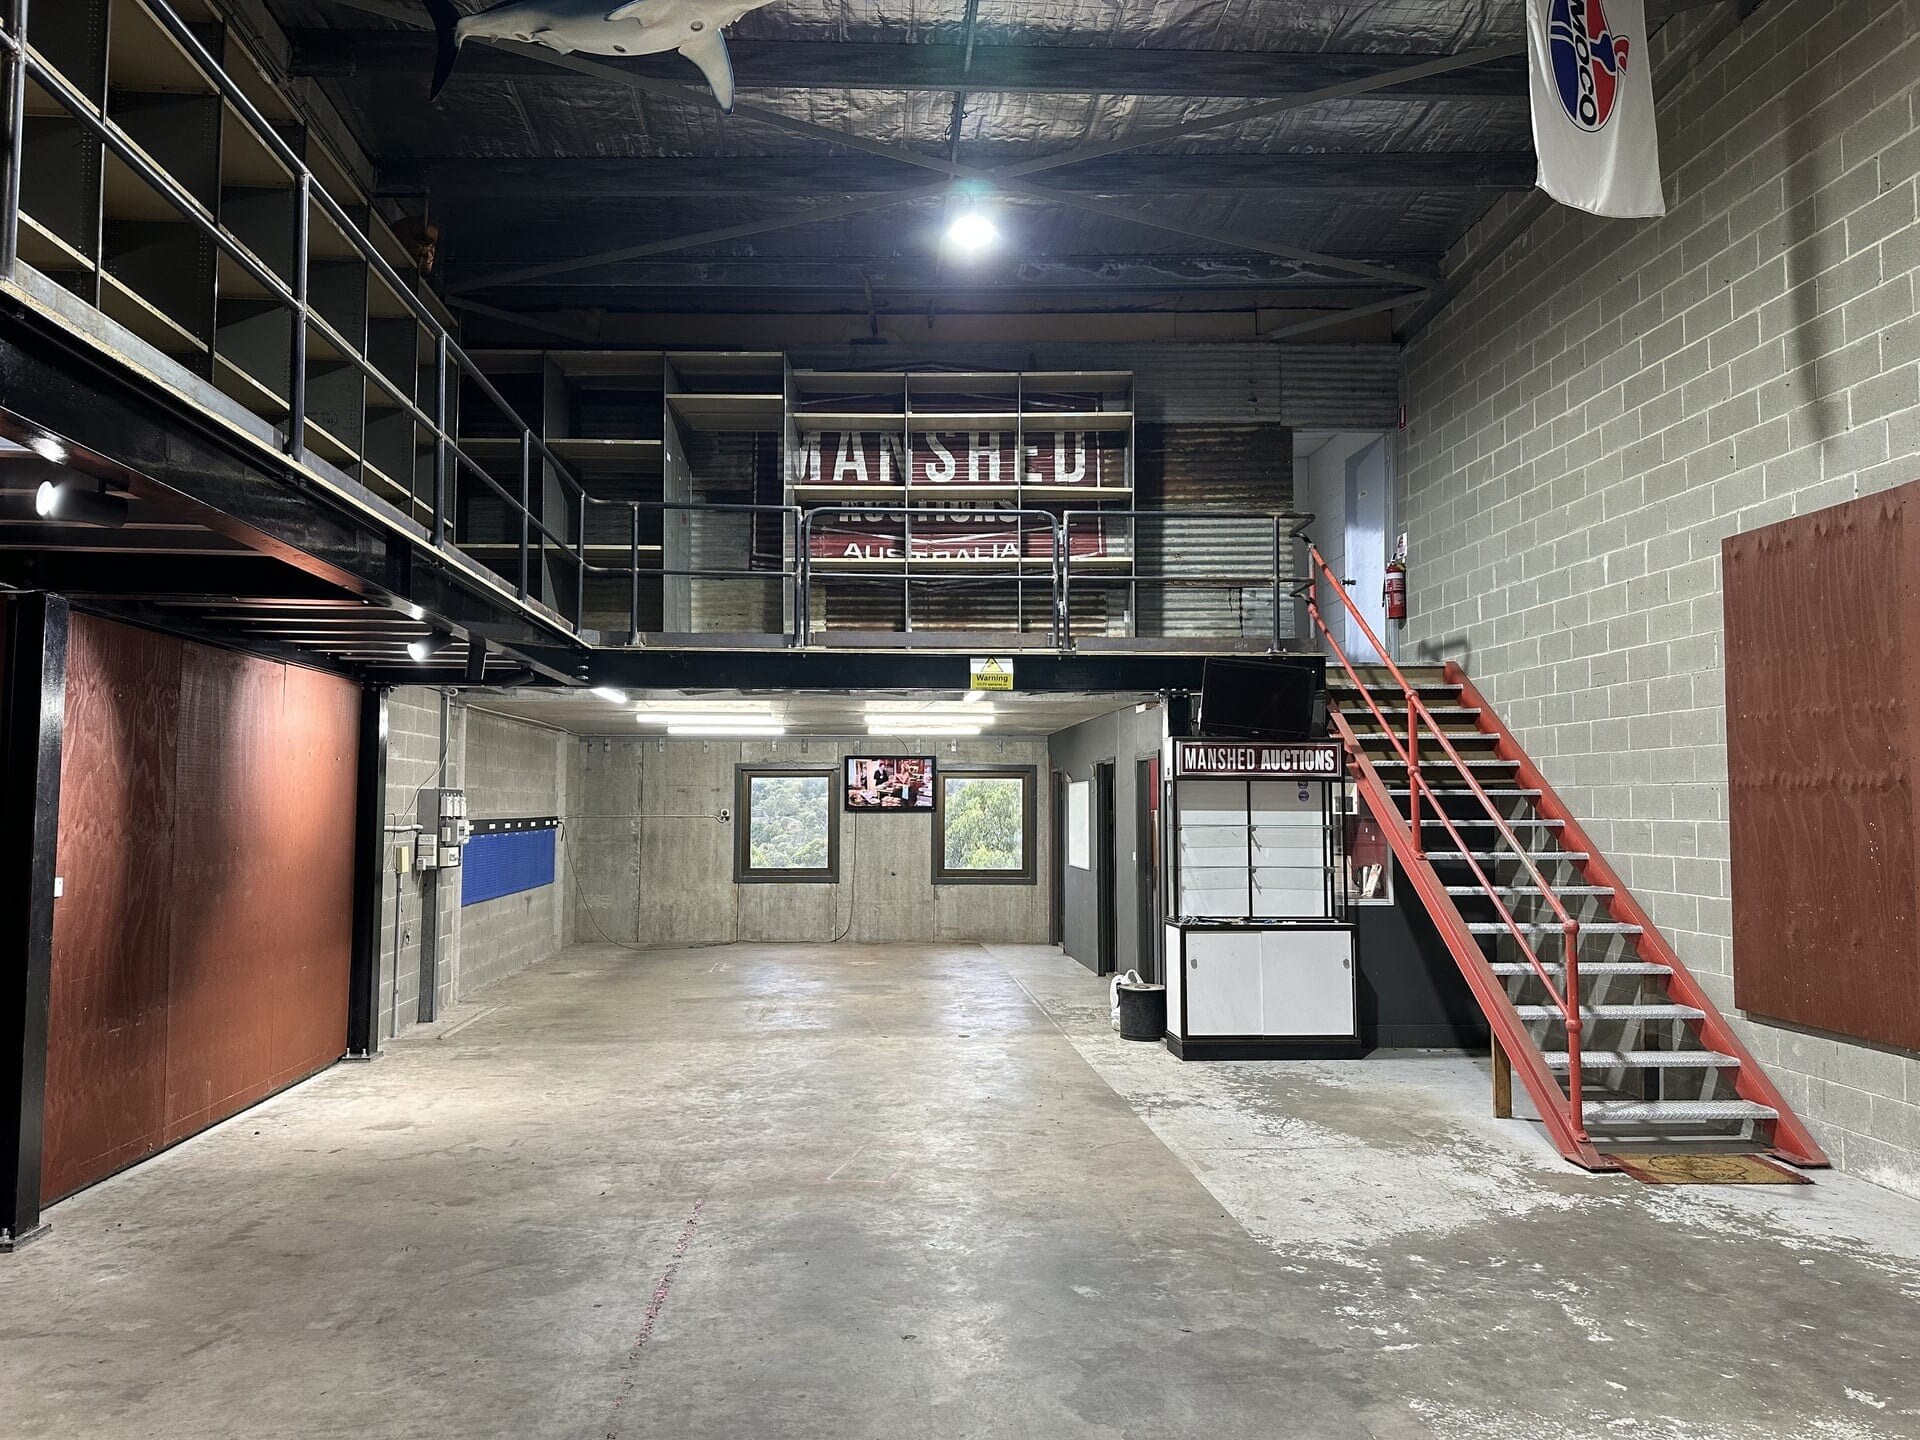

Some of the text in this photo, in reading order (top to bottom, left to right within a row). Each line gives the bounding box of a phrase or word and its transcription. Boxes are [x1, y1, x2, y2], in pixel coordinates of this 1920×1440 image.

[976, 674, 1008, 682] Warning
[1184, 748, 1335, 771] MANSHED AUCTIONS
